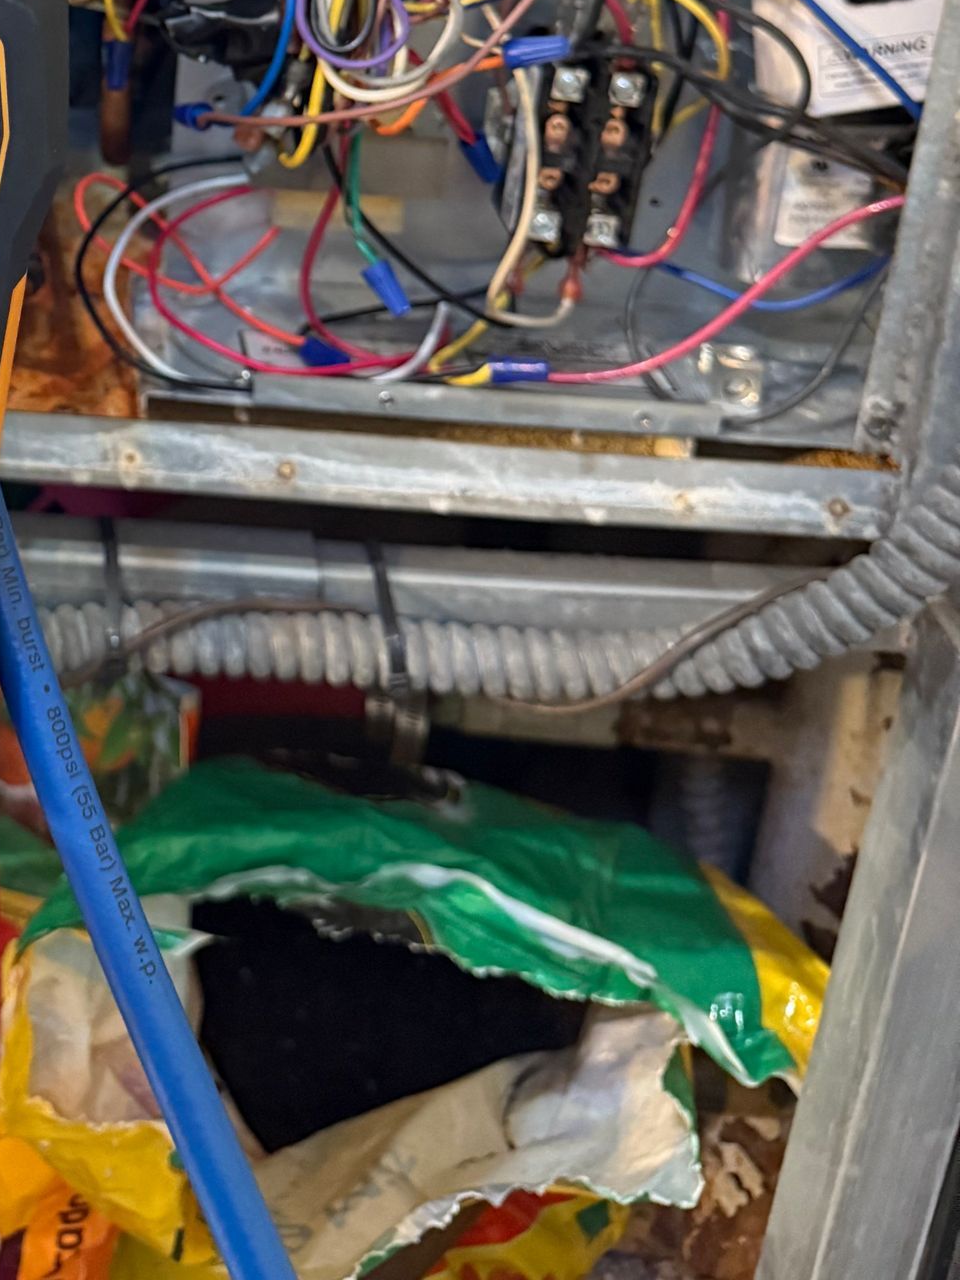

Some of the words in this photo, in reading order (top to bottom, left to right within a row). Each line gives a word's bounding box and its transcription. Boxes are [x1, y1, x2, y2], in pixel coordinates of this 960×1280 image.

[2, 566, 22, 610] Min.
[17, 617, 45, 672] burst
[47, 706, 82, 778] 800psi
[71, 784, 98, 820] (55
[90, 824, 117, 872] Bar)
[109, 876, 137, 931] Max.
[133, 936, 159, 985] w.p.
